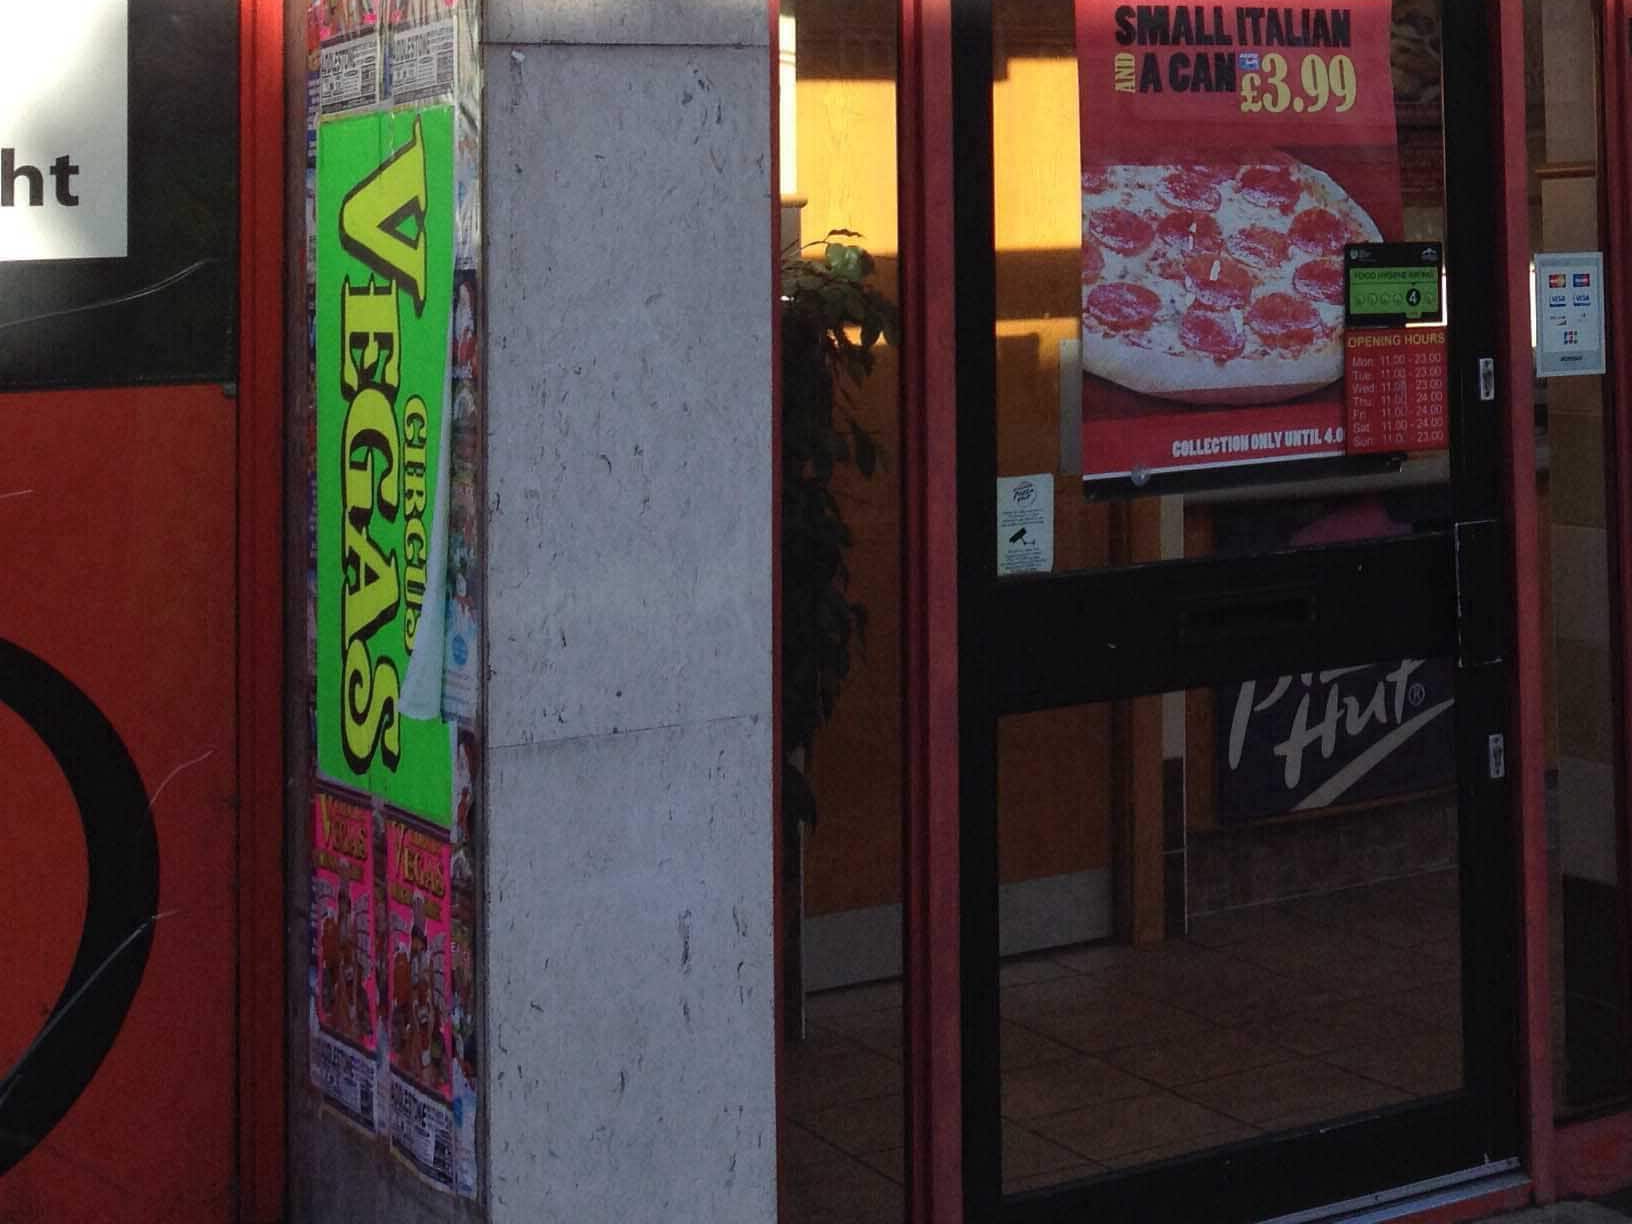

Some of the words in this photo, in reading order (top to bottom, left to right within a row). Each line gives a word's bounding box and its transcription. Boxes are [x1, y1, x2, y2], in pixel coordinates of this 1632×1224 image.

[1115, 5, 1233, 47] SMALL
[1236, 7, 1352, 48] ITALIAN
[1115, 53, 1136, 94] AND
[1139, 52, 1162, 93] A
[1168, 52, 1236, 93] CAN
[1240, 53, 1357, 113] £3.99
[1348, 334, 1400, 348] OPENING
[1404, 332, 1445, 345] HOURS
[338, 115, 428, 775] VEGAS
[1172, 434, 1249, 458] COLLECTION
[1251, 431, 1283, 451] ONLY
[1284, 428, 1322, 447] UNTIL
[1324, 427, 1344, 443] 4.0
[402, 393, 428, 657] CIRCUS
